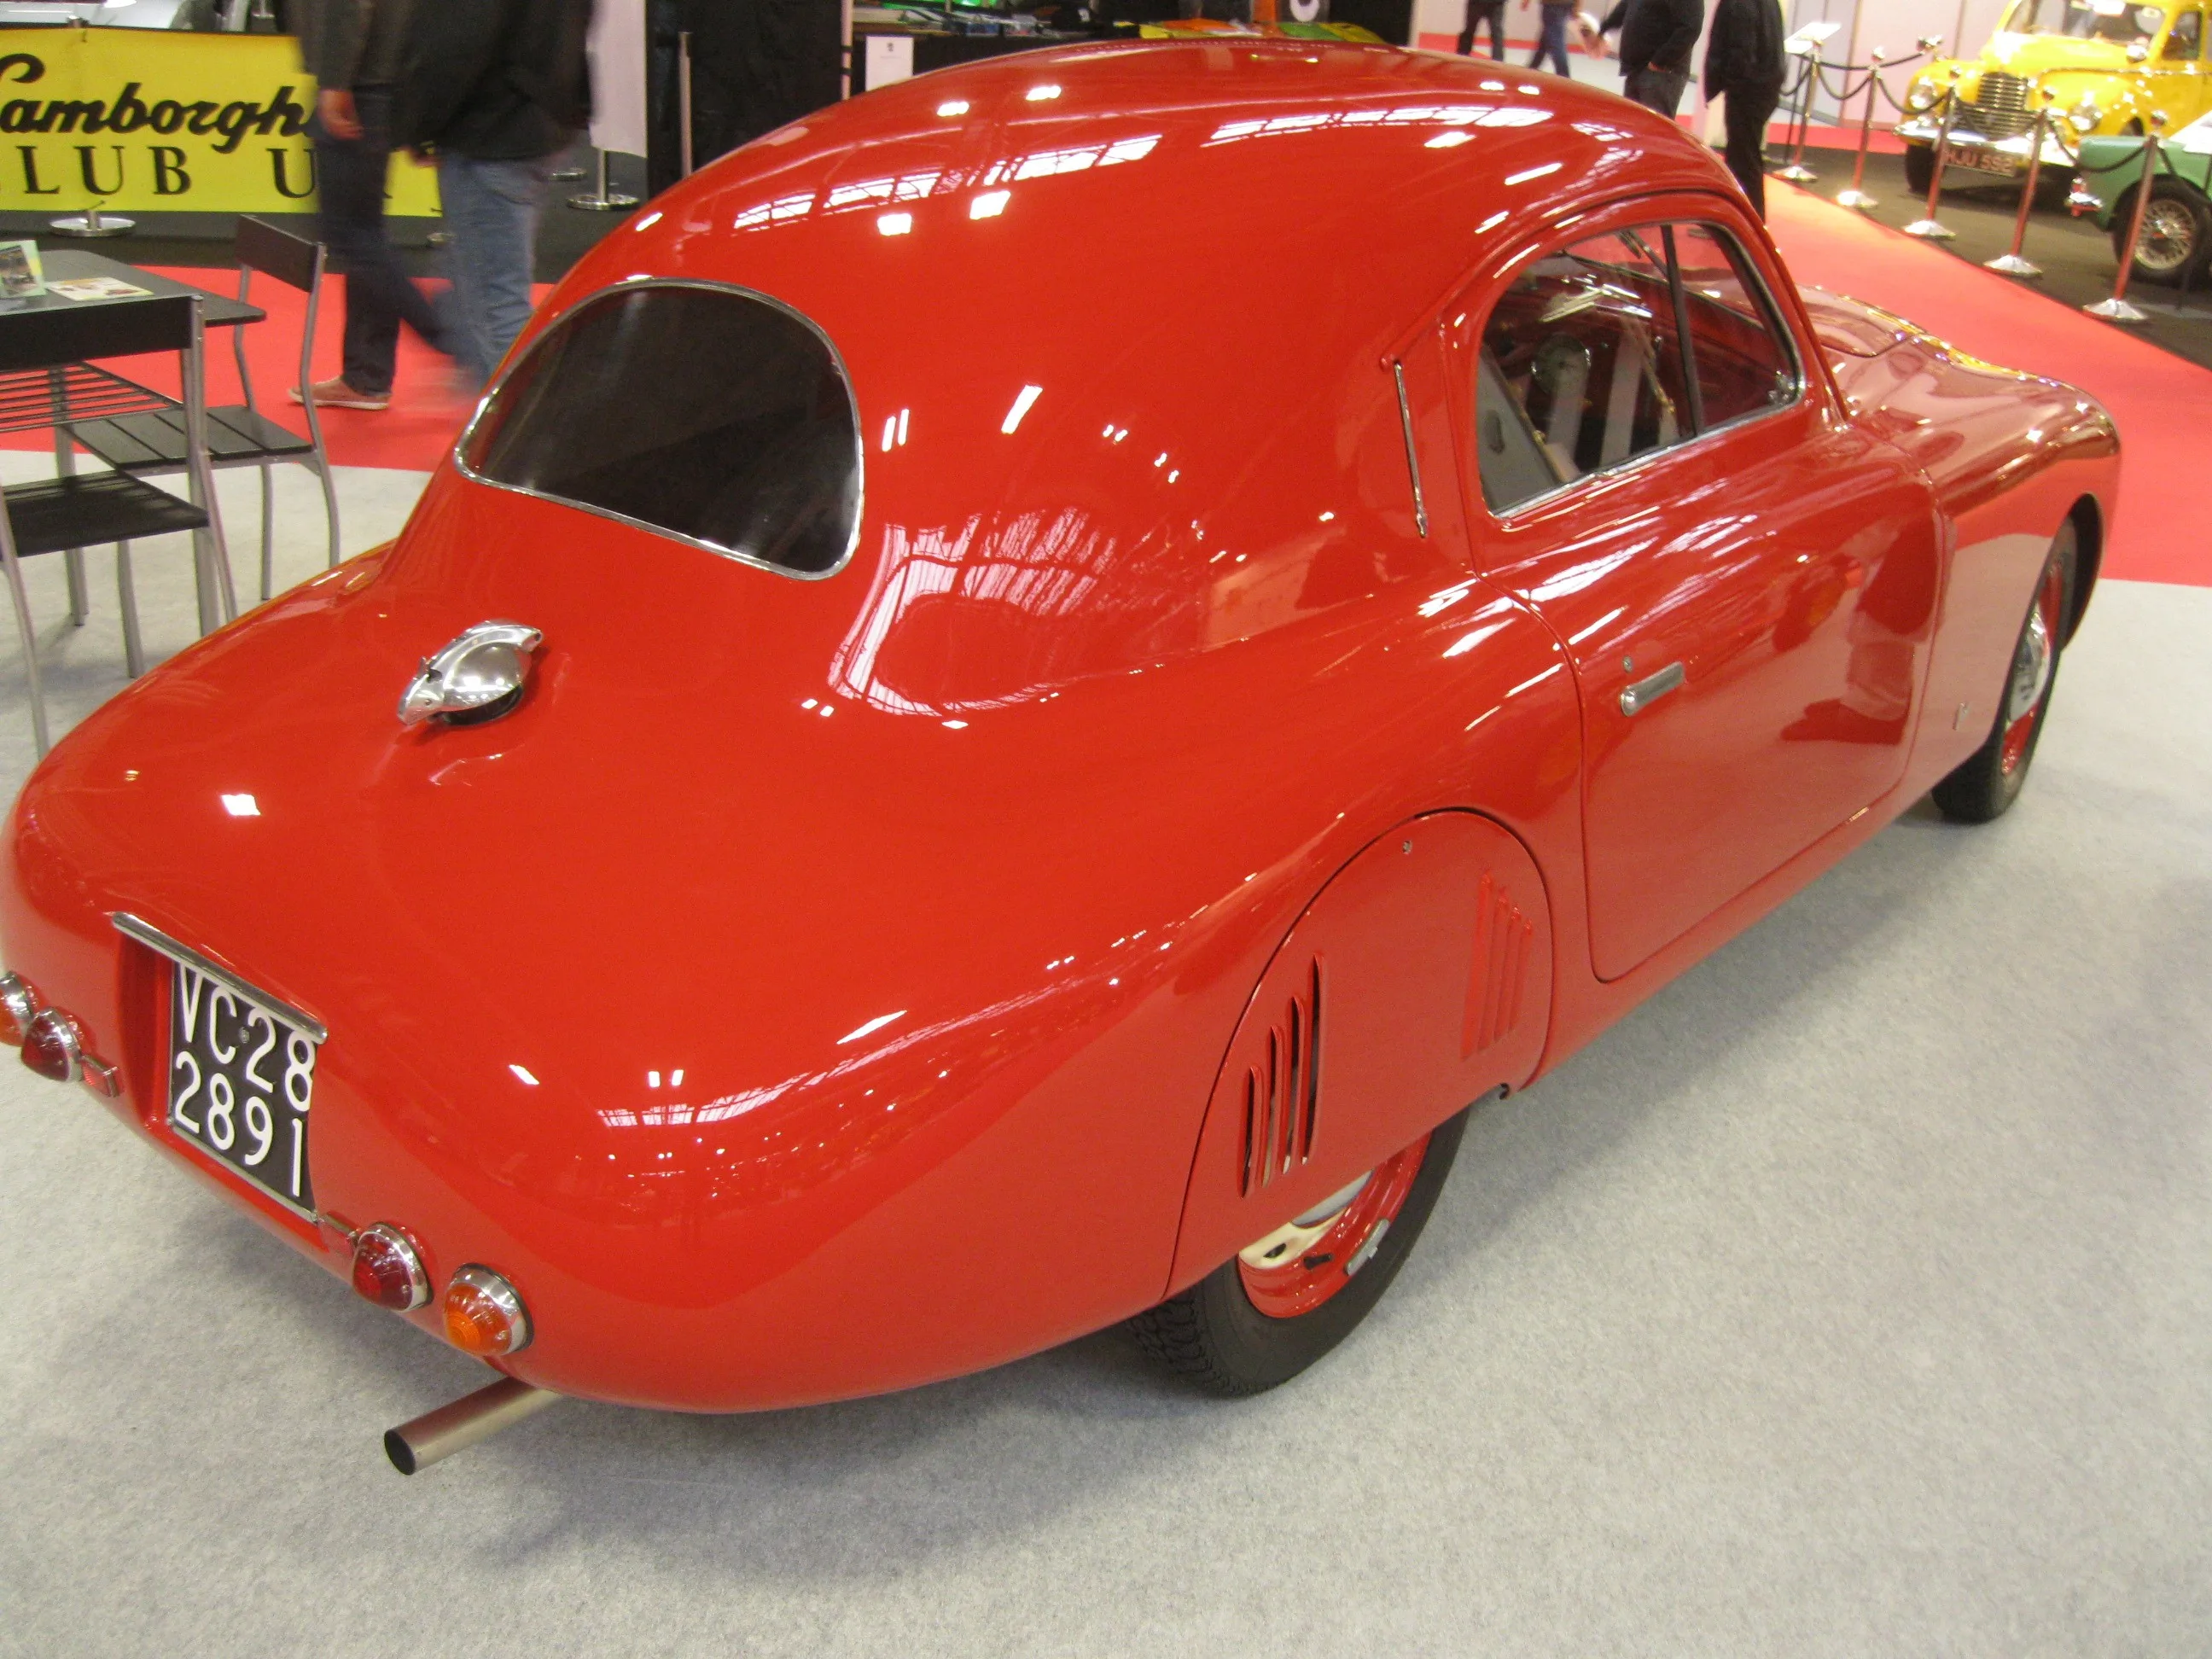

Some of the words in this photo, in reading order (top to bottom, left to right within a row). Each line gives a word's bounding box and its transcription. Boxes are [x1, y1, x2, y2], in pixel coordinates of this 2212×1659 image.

[0, 53, 312, 154] amborgh
[15, 144, 191, 196] LUB
[265, 148, 318, 199] U
[174, 1050, 304, 1198] 2891
